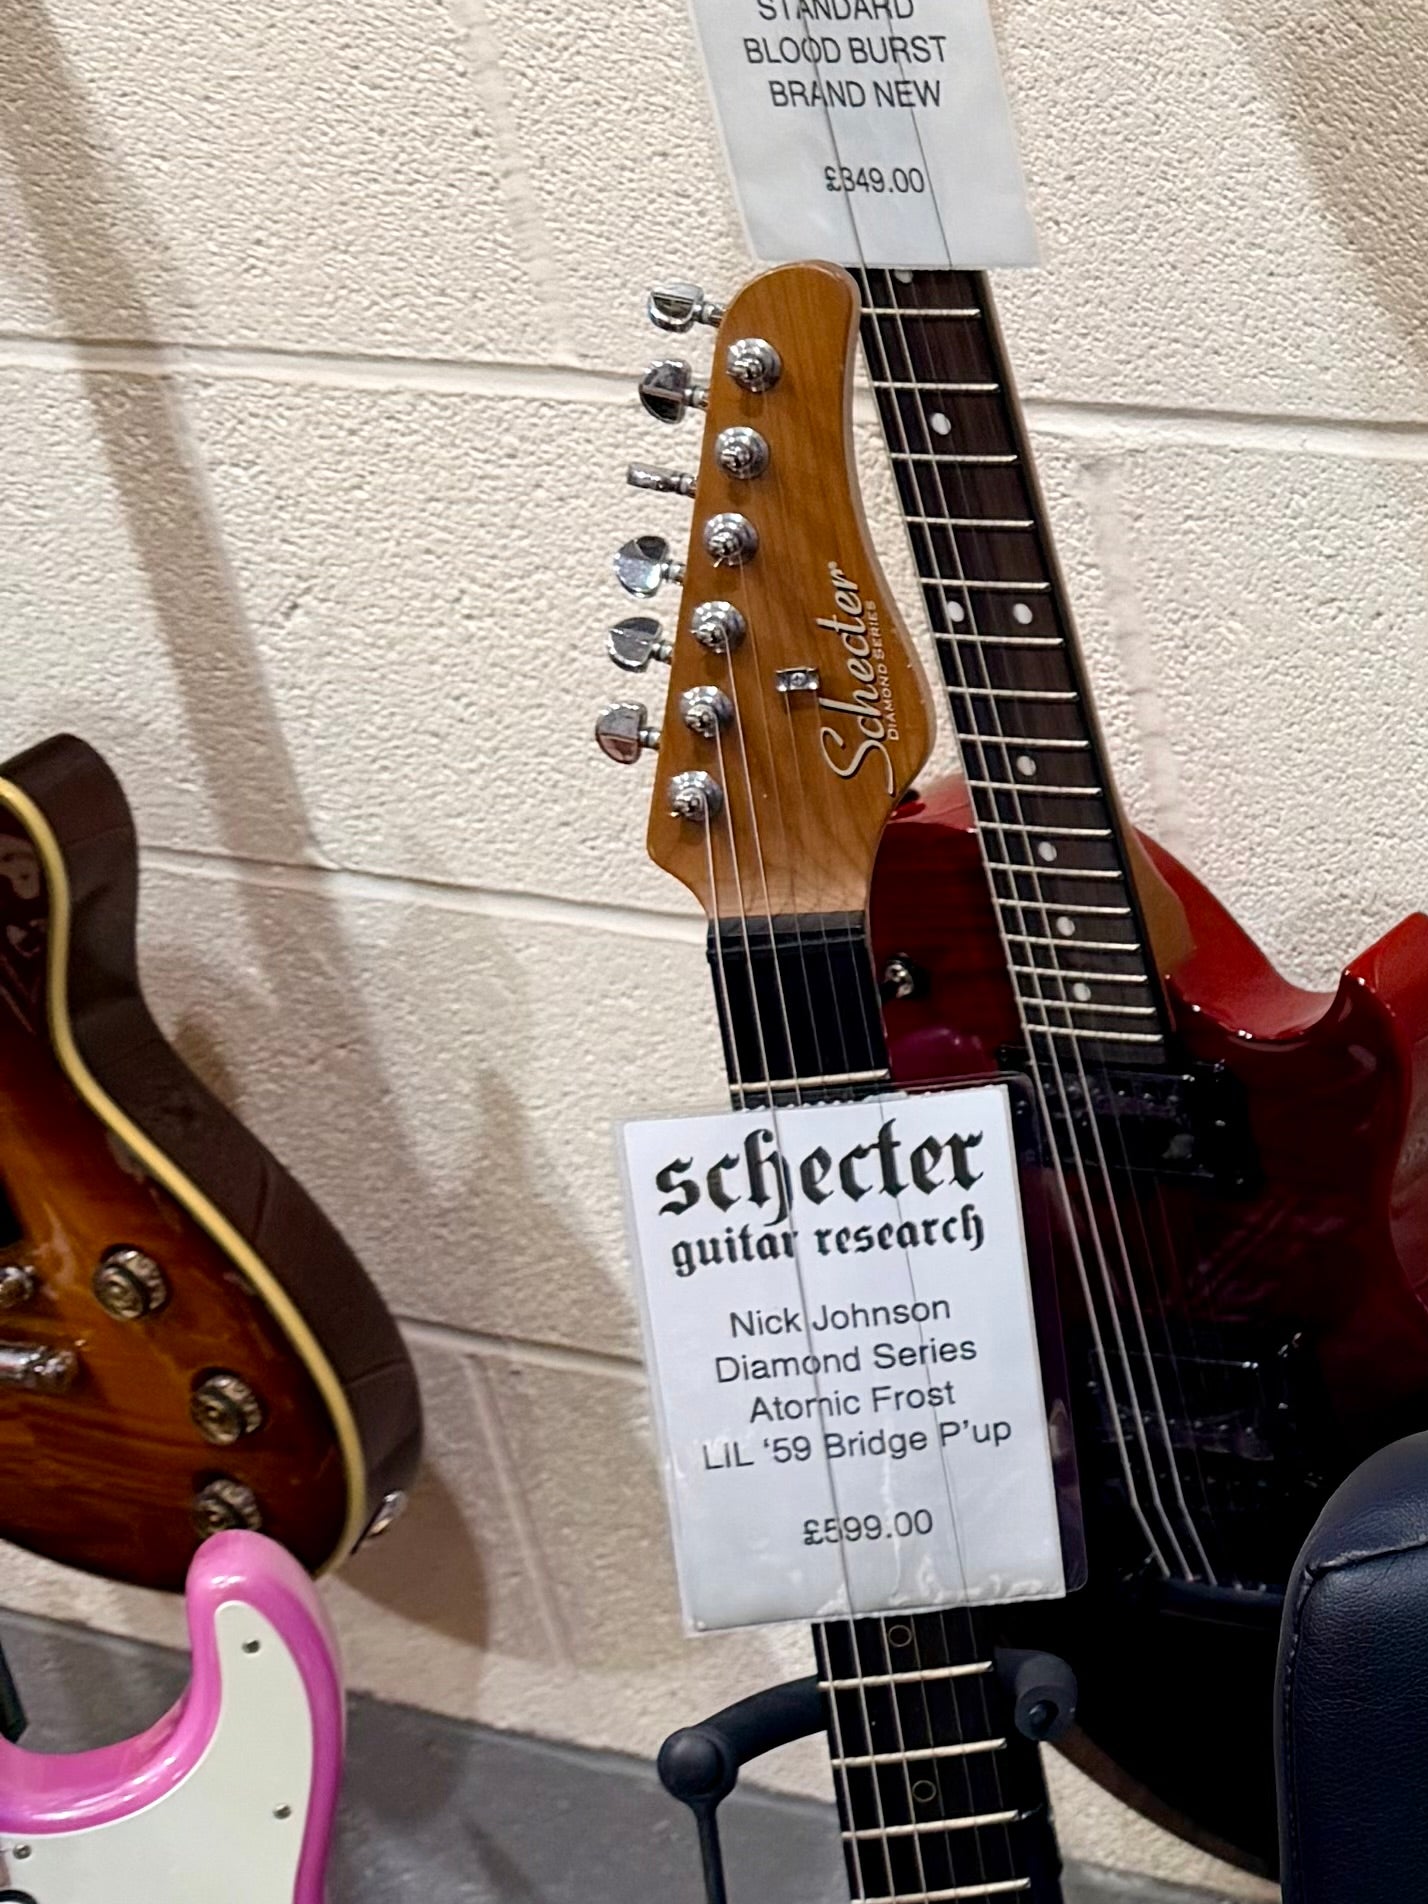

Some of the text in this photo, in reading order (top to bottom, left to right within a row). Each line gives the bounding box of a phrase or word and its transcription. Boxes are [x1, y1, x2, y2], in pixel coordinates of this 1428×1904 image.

[743, 35, 948, 66] BLOOD BURST
[768, 79, 942, 108] BRAND NEW
[824, 166, 925, 194] £349.00
[815, 561, 896, 795] Schecter
[864, 600, 900, 741] DIAMOND SERIES
[655, 1117, 985, 1227] schecter
[671, 1203, 986, 1278] guitar research
[729, 1298, 952, 1339] Nick Johnson
[714, 1336, 978, 1384] Diamond Series
[749, 1378, 957, 1424] Atomic Frost
[824, 1428, 929, 1463] Bridge
[802, 1507, 935, 1547] £599.00
